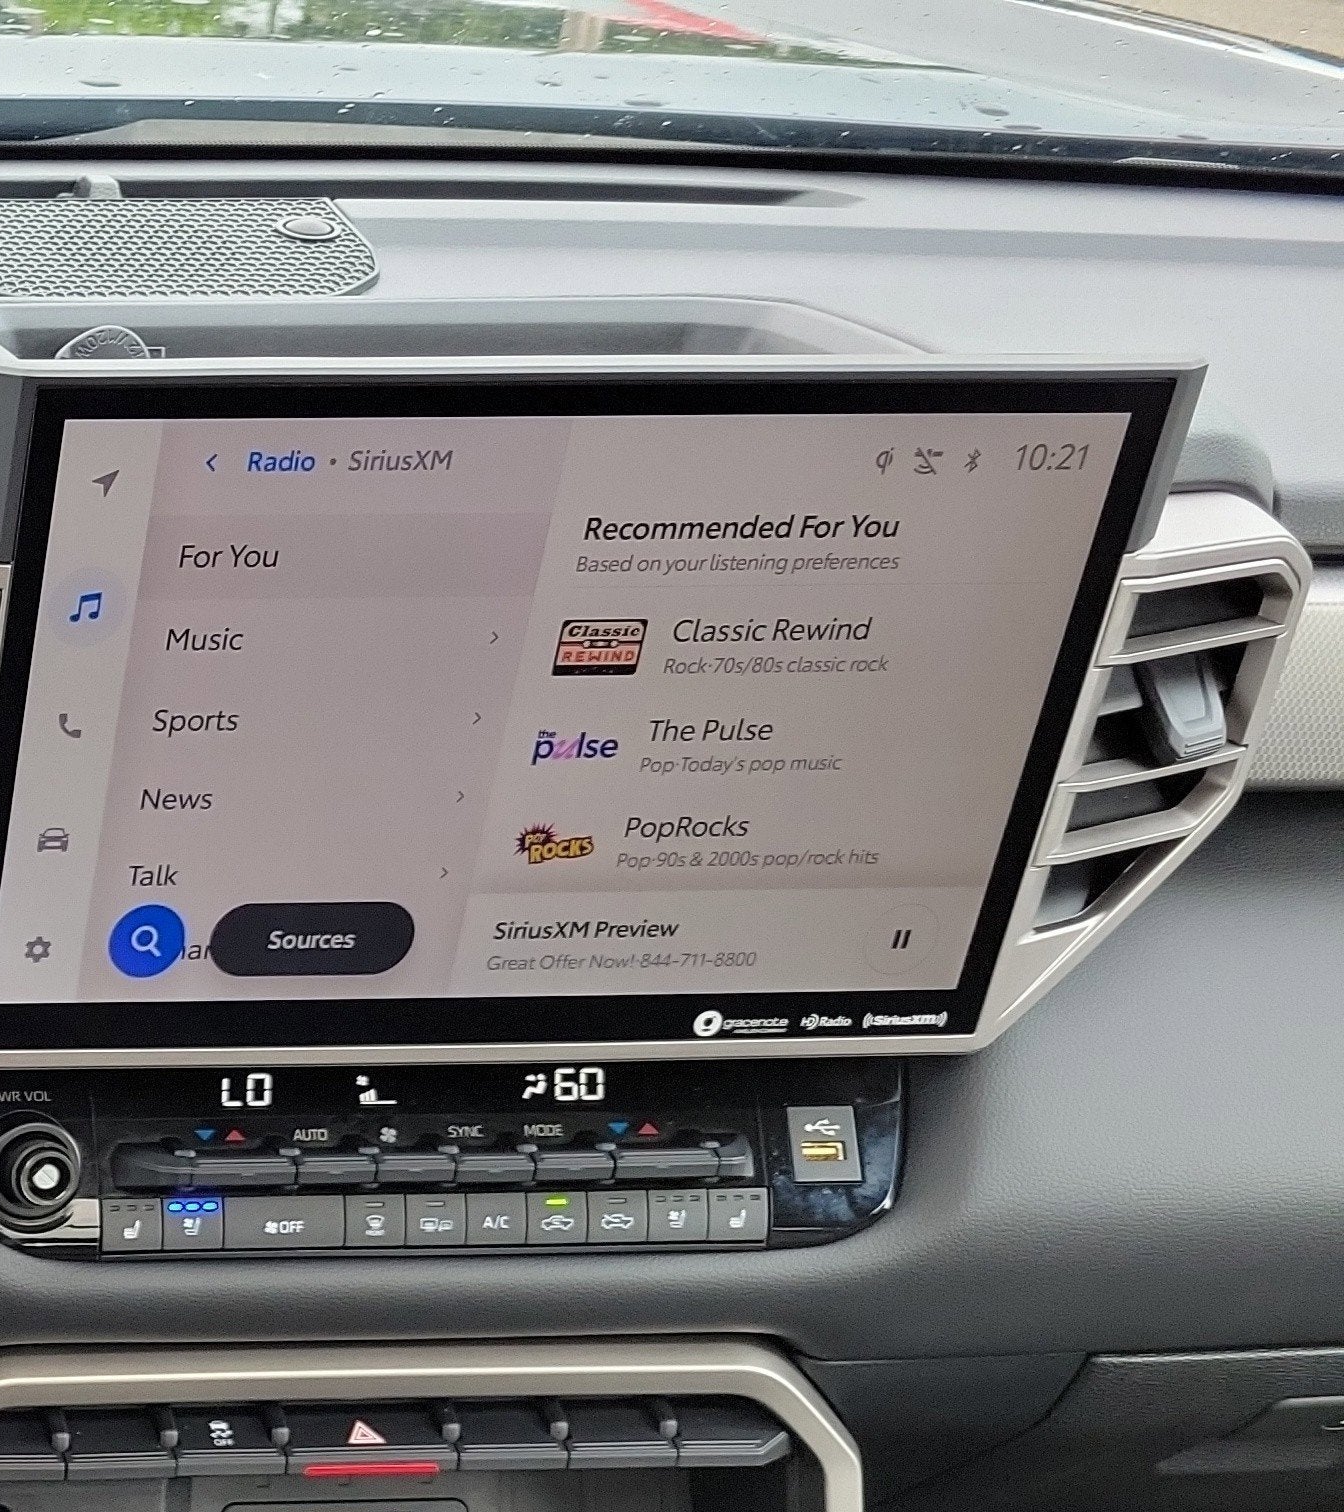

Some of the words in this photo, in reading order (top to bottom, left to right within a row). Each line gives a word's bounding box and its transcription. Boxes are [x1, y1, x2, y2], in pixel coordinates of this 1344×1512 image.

[246, 450, 317, 474] Radio
[347, 449, 454, 473] SiriusXM
[1013, 443, 1091, 471] 10:21
[583, 514, 793, 542] Recommended
[798, 514, 845, 541] For
[851, 512, 900, 539] You
[178, 545, 223, 569] For
[230, 544, 280, 569] You
[575, 554, 632, 574] Based
[634, 557, 659, 573] on
[660, 558, 706, 576] your
[709, 551, 788, 576] listening
[790, 551, 901, 575] preferences
[164, 628, 244, 652] Music
[568, 625, 641, 637] Classic
[672, 616, 768, 644] Classic
[775, 615, 872, 642] Rewind
[786, 655, 846, 673] classic
[848, 654, 890, 672] rock
[151, 709, 239, 738] Sports
[649, 718, 696, 742] The
[701, 717, 774, 741] Pulse
[747, 757, 786, 773] pop
[789, 754, 843, 771] music
[139, 788, 213, 811] News
[623, 815, 750, 840] PopRocks
[706, 849, 760, 867] 2000s
[761, 848, 845, 868] pop/rock
[847, 847, 879, 866] hits
[128, 864, 179, 888] Talk
[266, 930, 356, 950] Sources
[493, 920, 590, 940] SiriusXM
[594, 919, 680, 939] Preview
[486, 955, 537, 971] Great
[539, 954, 584, 970] Offer
[220, 1072, 274, 1108] LO
[552, 1066, 606, 1101] 60
[24, 1090, 52, 1102] VOL
[293, 1128, 329, 1142] AUTO
[447, 1124, 485, 1138] SYNC
[523, 1123, 564, 1138] MODE
[279, 1219, 306, 1235] OFF
[481, 1213, 511, 1230] A/C
